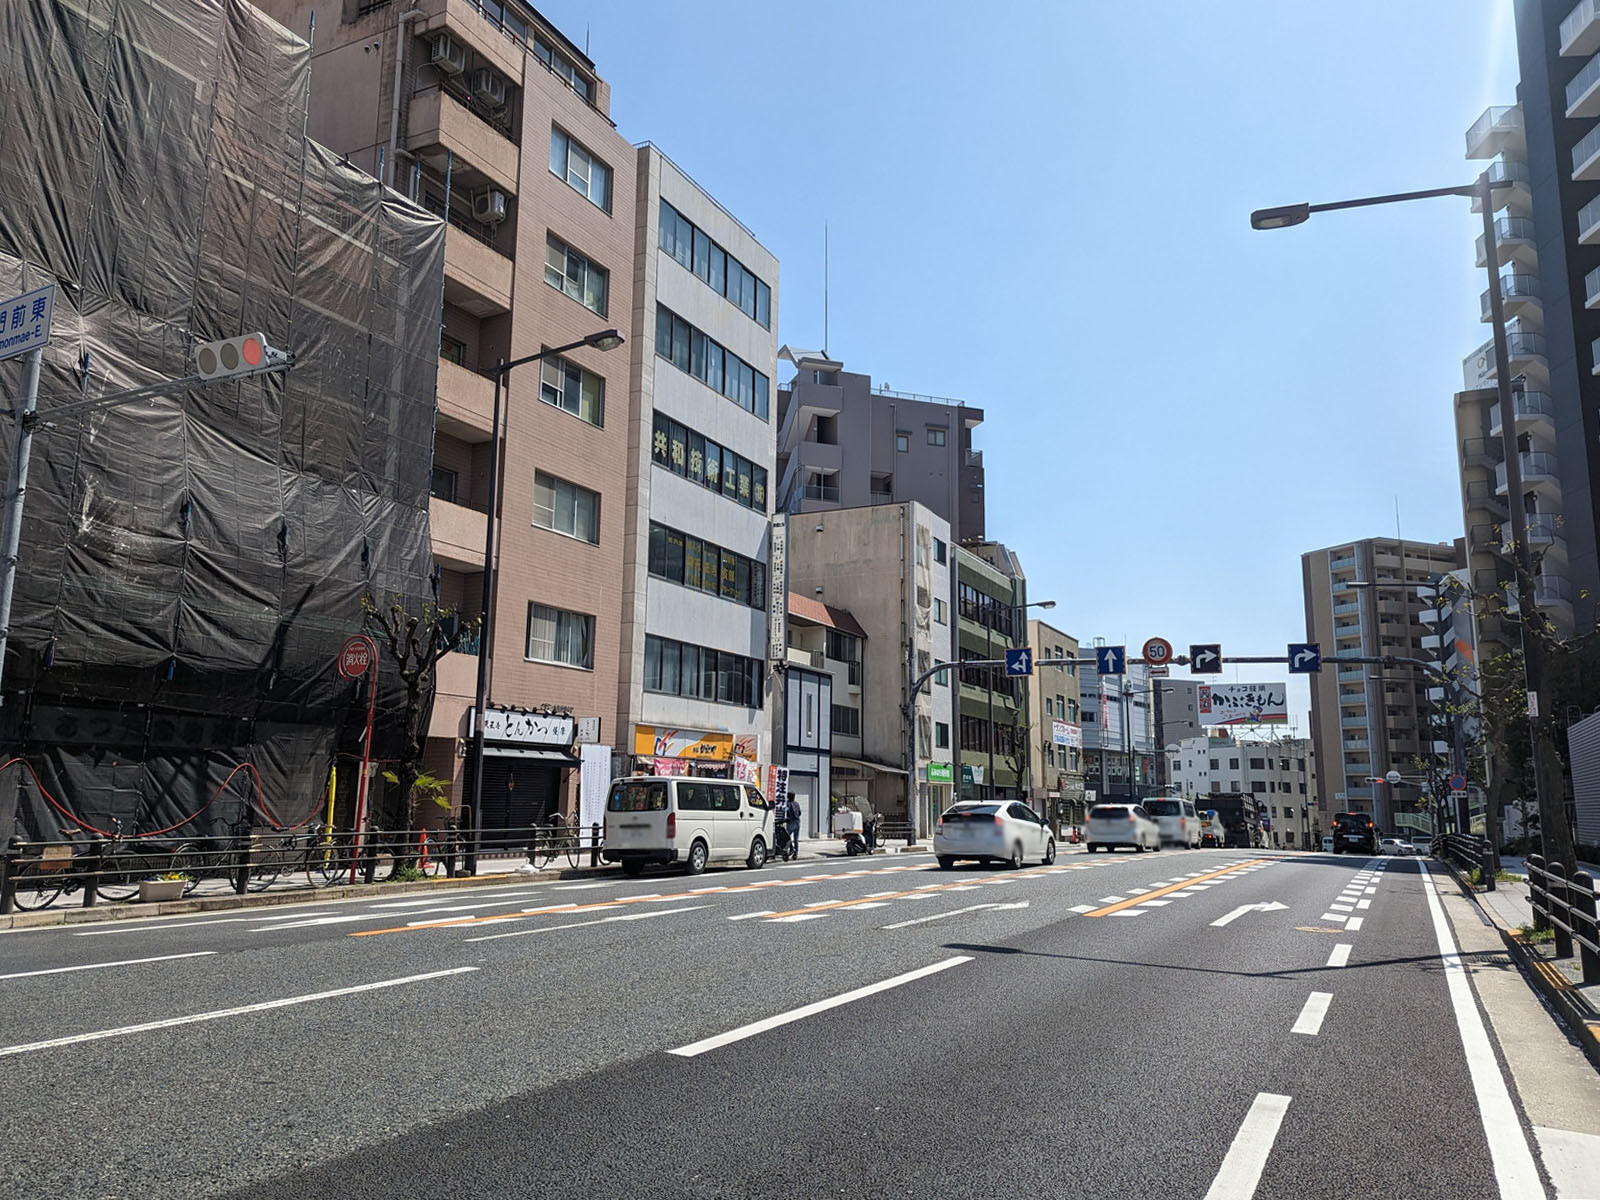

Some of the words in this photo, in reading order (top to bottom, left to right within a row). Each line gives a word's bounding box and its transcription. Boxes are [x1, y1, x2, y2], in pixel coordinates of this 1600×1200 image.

[346, 652, 367, 666] 消火栓
[1149, 645, 1165, 658] 50
[1212, 692, 1284, 708] かぶきもん
[505, 714, 548, 738] とんかつ
